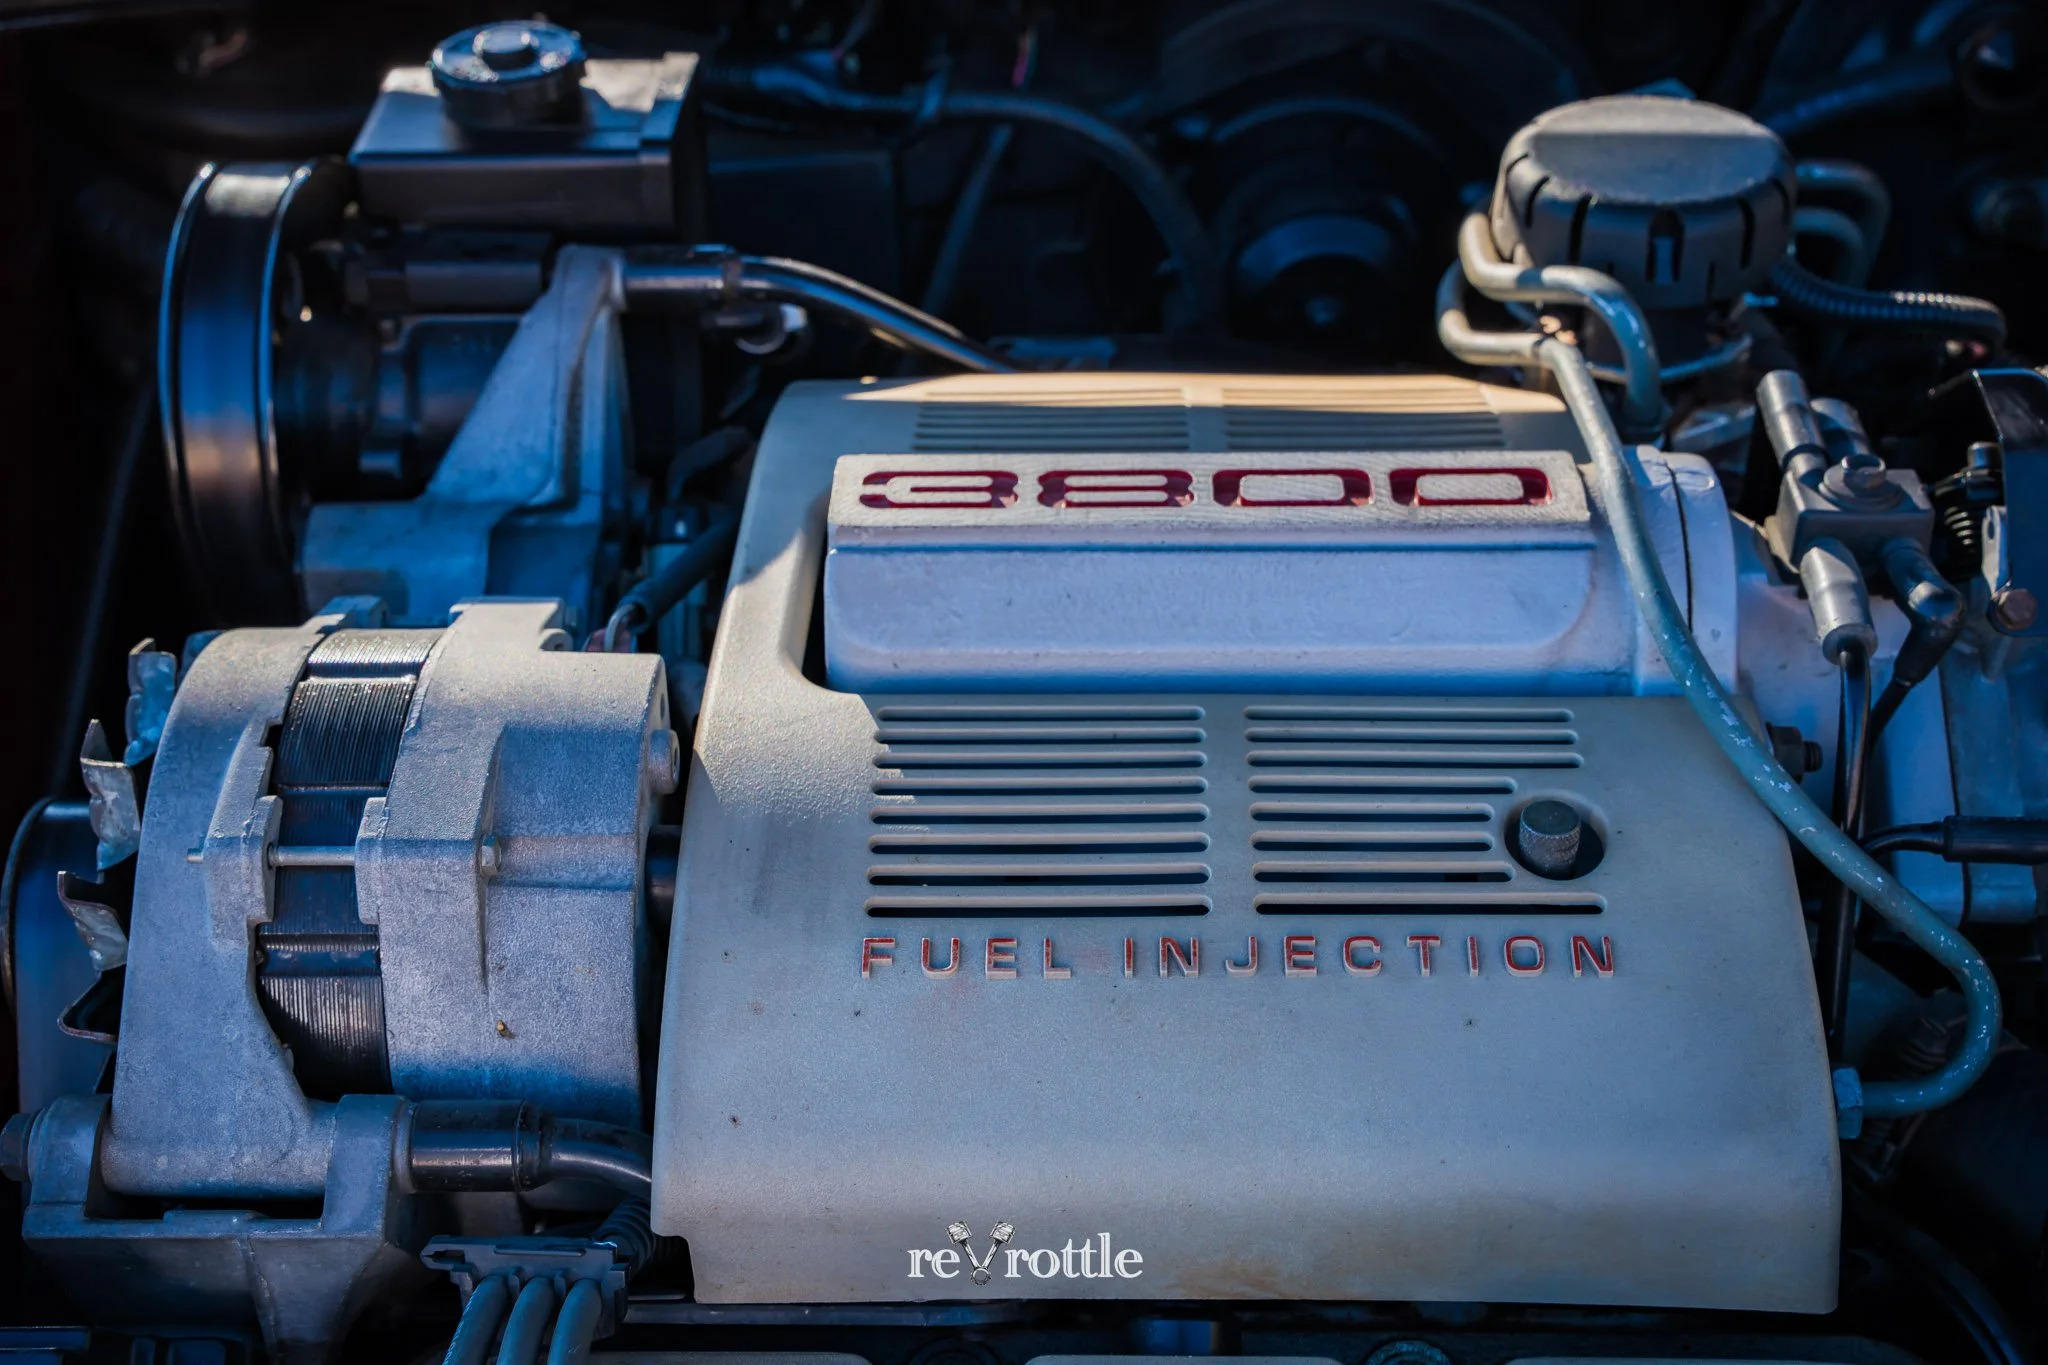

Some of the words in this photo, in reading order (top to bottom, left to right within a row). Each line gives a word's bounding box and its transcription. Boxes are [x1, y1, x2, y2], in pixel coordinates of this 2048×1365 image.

[860, 467, 1553, 508] 3800
[861, 936, 1072, 979] FUEL
[1123, 935, 1616, 979] INJECTION
